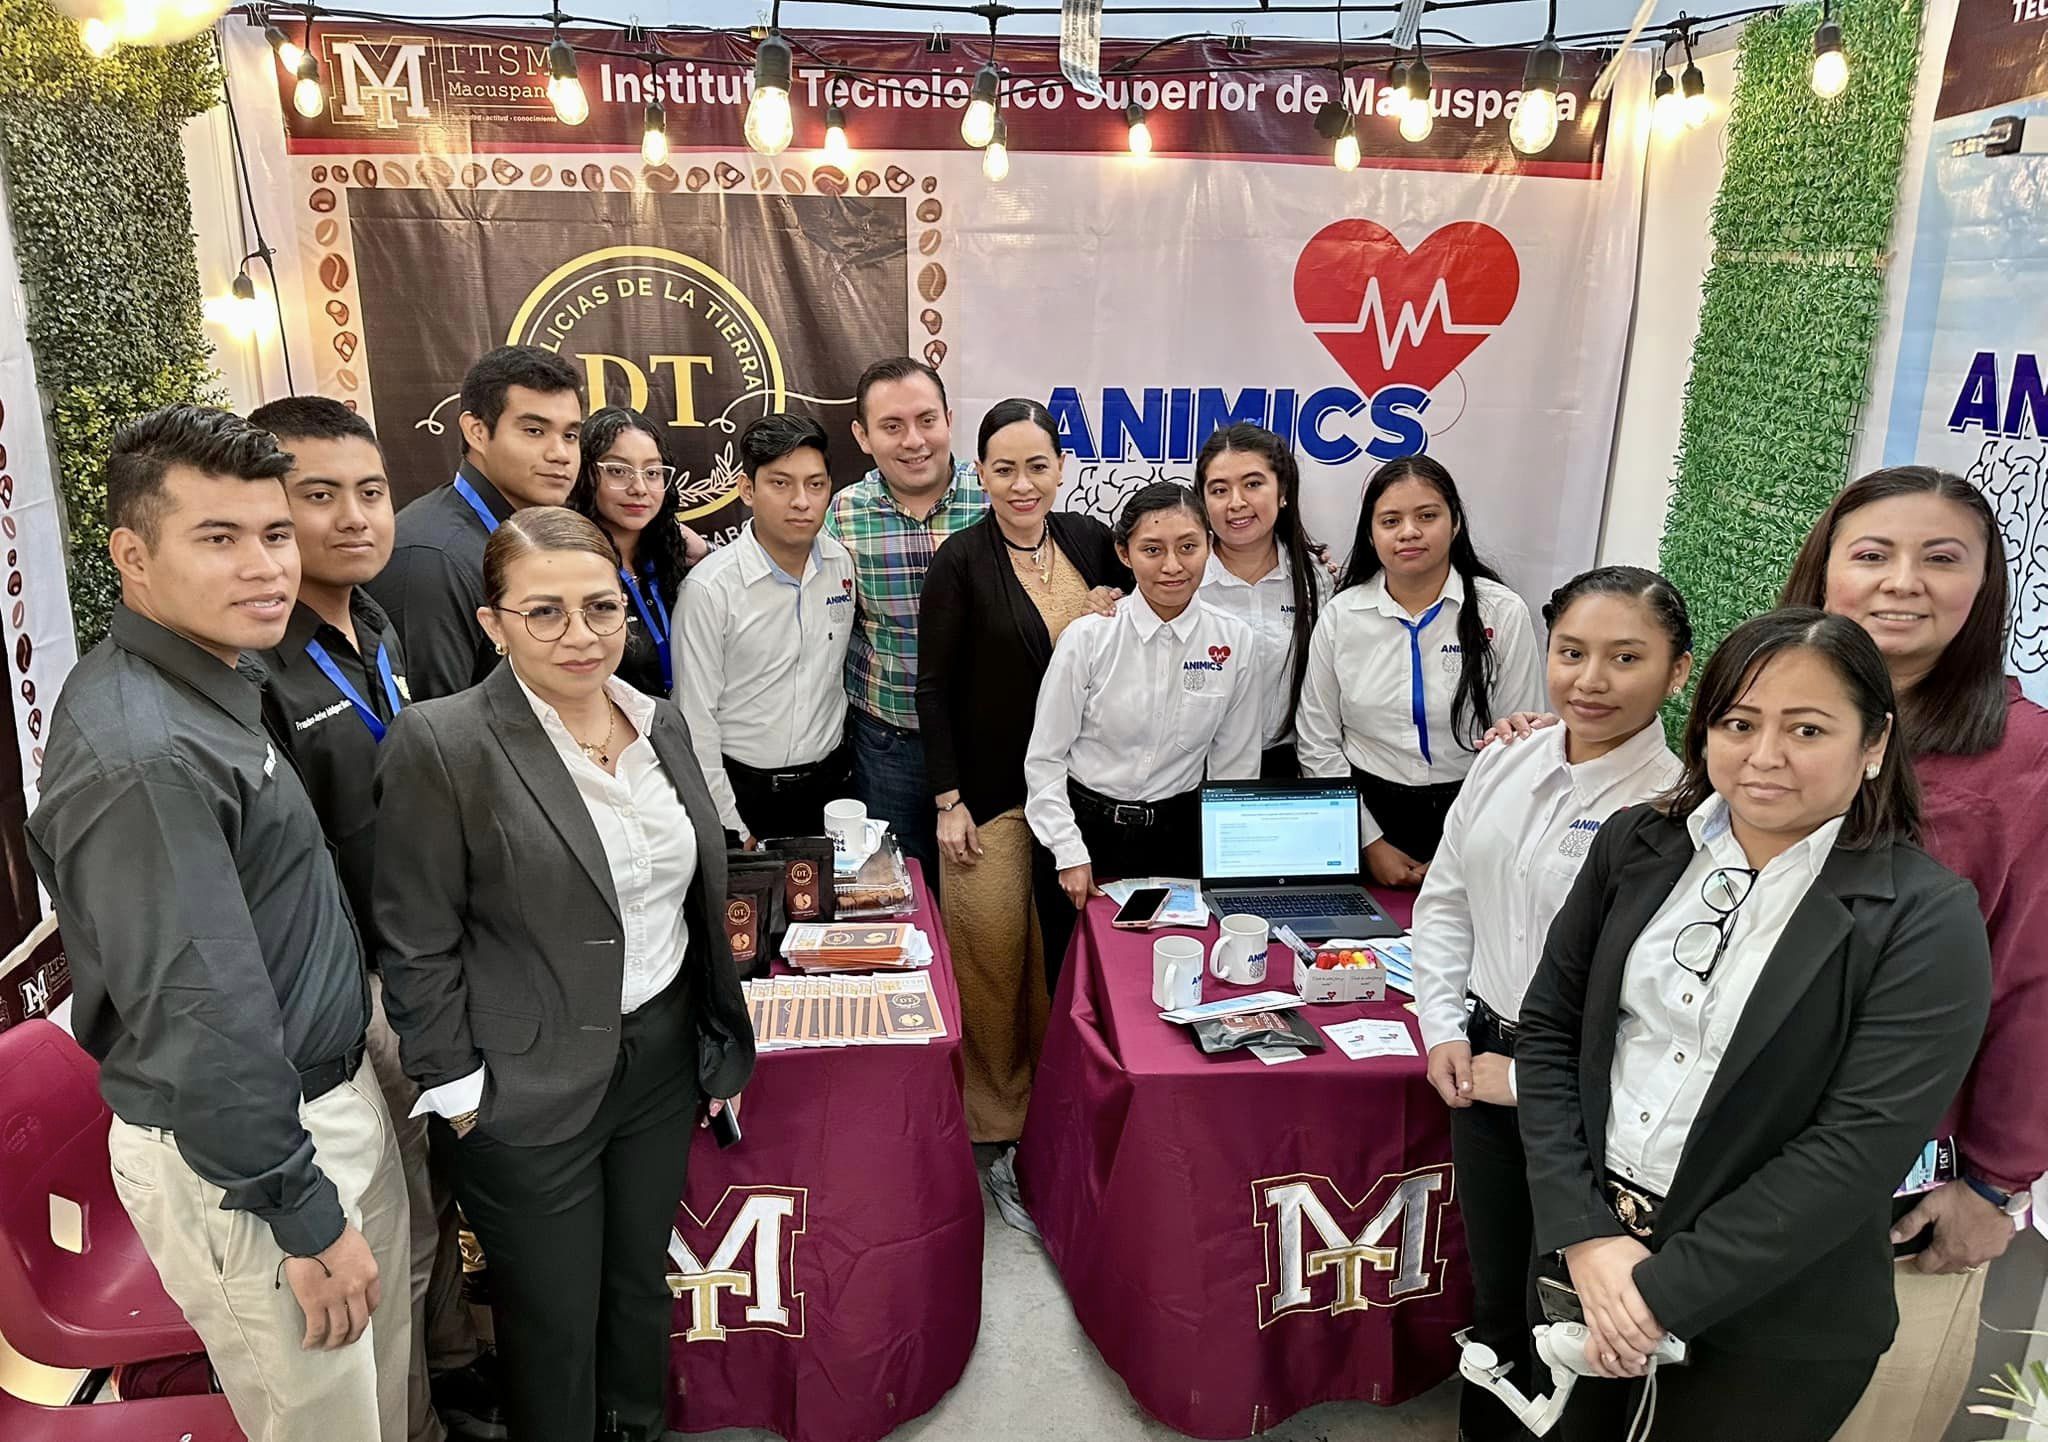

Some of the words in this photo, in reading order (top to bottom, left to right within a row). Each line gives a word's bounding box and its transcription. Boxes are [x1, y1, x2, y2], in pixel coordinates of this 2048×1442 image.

[447, 44, 552, 76] ITSM
[448, 81, 547, 101] Macuspan
[600, 62, 758, 105] Institut
[799, 66, 1064, 110] Tecnolóico
[1275, 75, 1329, 113] de
[1343, 77, 1577, 127] Mauspaa
[540, 284, 610, 354] LICIAS
[616, 277, 653, 298] DE
[664, 281, 696, 309] LA
[704, 300, 763, 391] TIERRA
[575, 352, 714, 428] DT
[1183, 660, 1223, 671] ANIMICS
